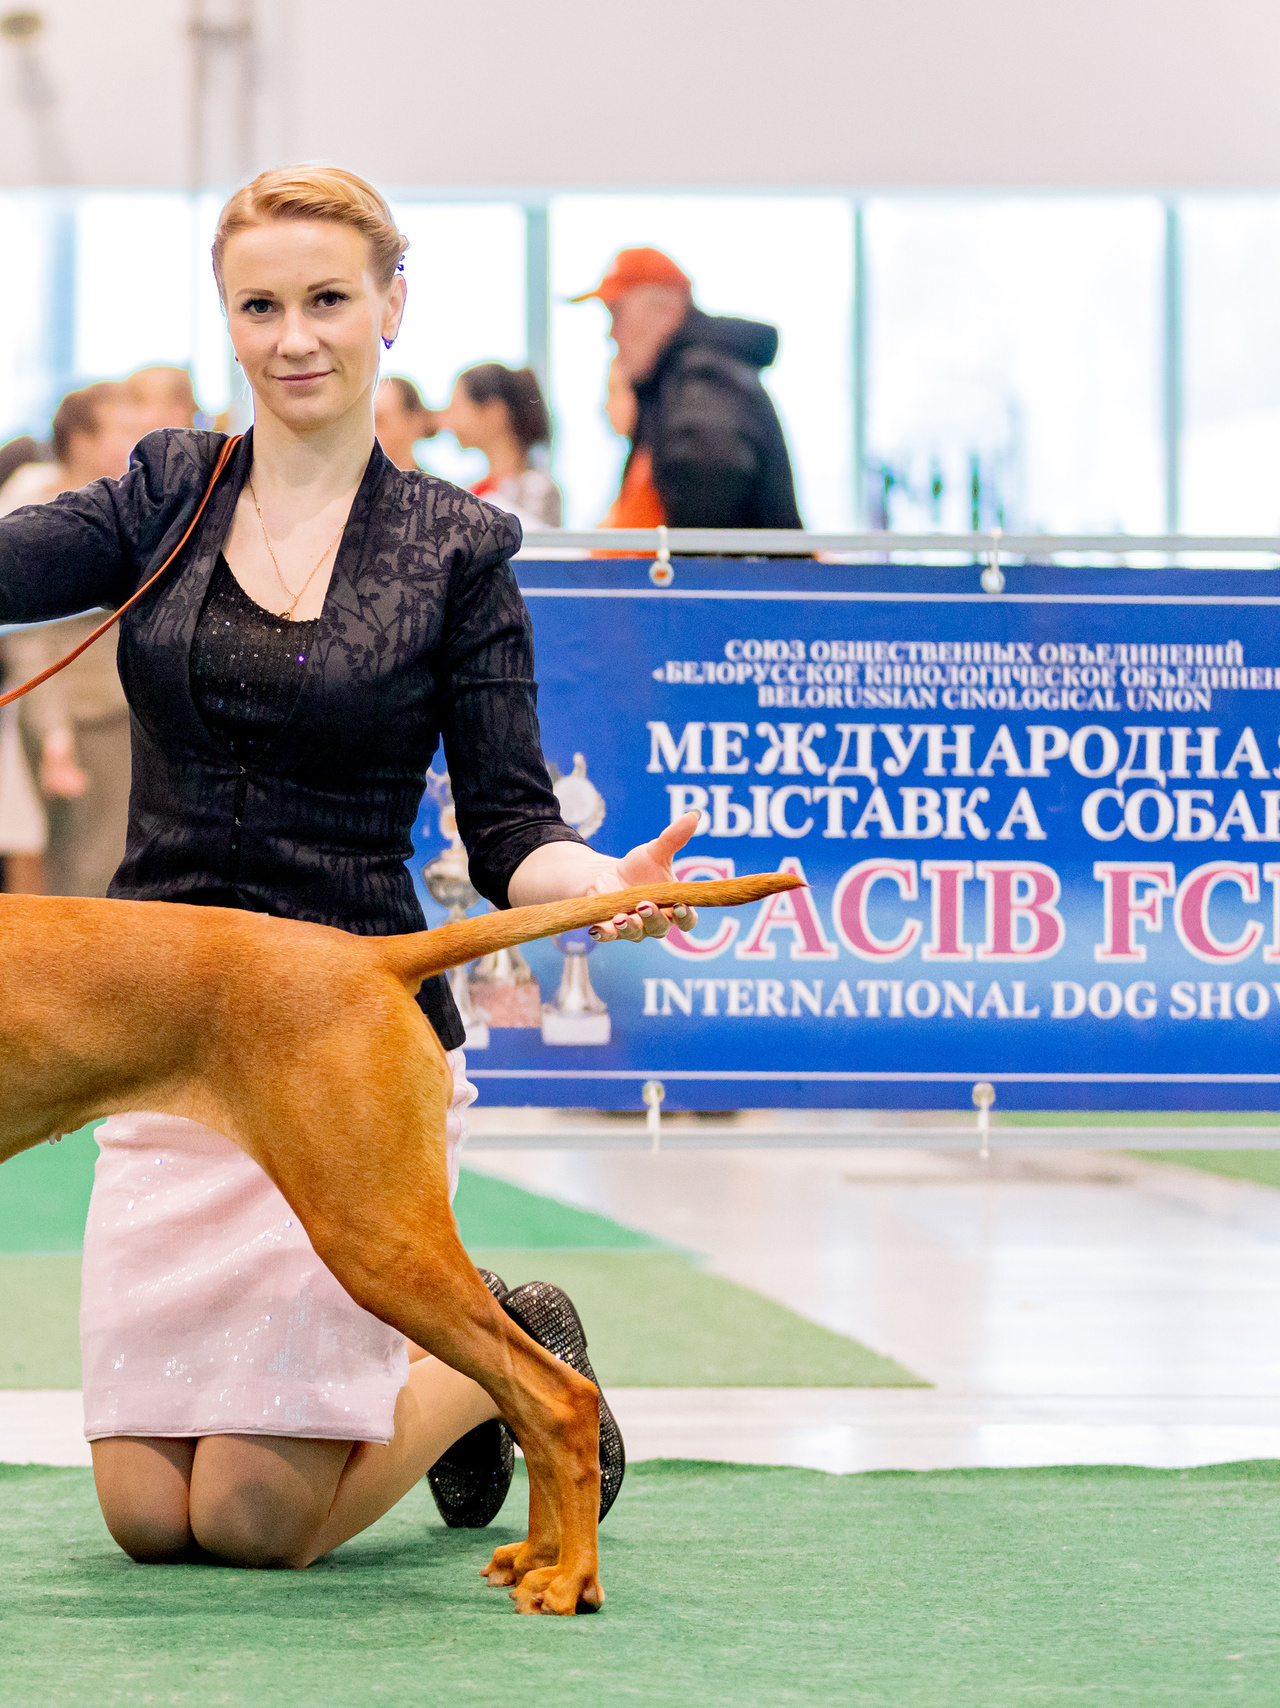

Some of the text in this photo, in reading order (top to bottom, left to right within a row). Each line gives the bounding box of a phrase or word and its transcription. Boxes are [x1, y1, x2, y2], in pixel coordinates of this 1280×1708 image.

[724, 639, 1244, 668] СОЮЗ ОБЩЕСТВЕННЫХ ОБЪЕДИНЕНИЙ
[864, 663, 1118, 689] КИНОЛОГИЧЕСКОЕ
[758, 684, 1212, 713] BELORUSSIAN CINOLOGICAL UNION
[646, 720, 1280, 789] МЕЖДУНАРОДНА
[665, 784, 1048, 840] ВЫСТАВКА
[658, 855, 1066, 964] CACIB
[642, 977, 1280, 1021] INTERNATIONAL DOG SHO
